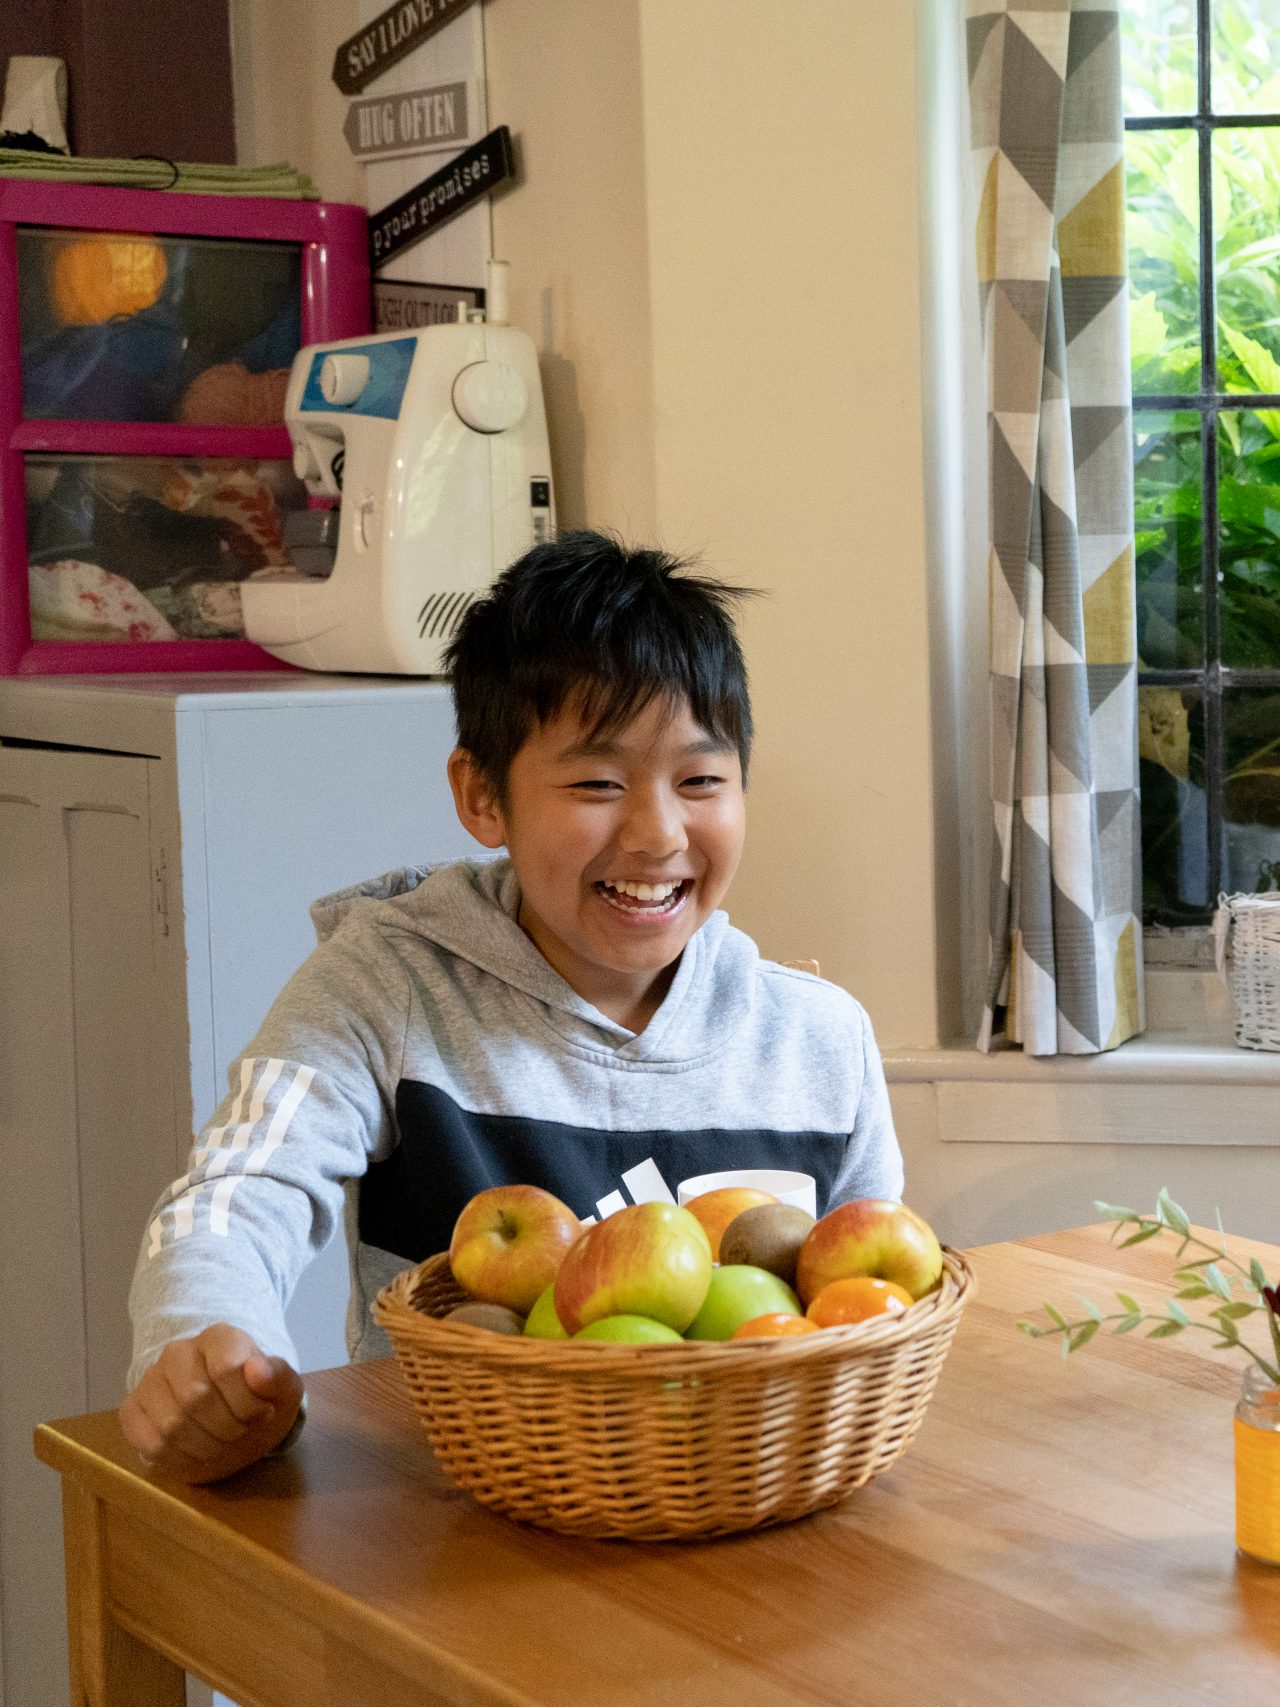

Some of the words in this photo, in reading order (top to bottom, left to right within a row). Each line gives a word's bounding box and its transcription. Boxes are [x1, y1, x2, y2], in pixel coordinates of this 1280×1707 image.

[347, 30, 376, 77] SAY
[379, 23, 388, 54] I
[387, 0, 434, 49] LOVE
[359, 103, 395, 149] HUG
[400, 91, 455, 141] OFTEN
[383, 202, 417, 249] your
[419, 154, 490, 225] promises
